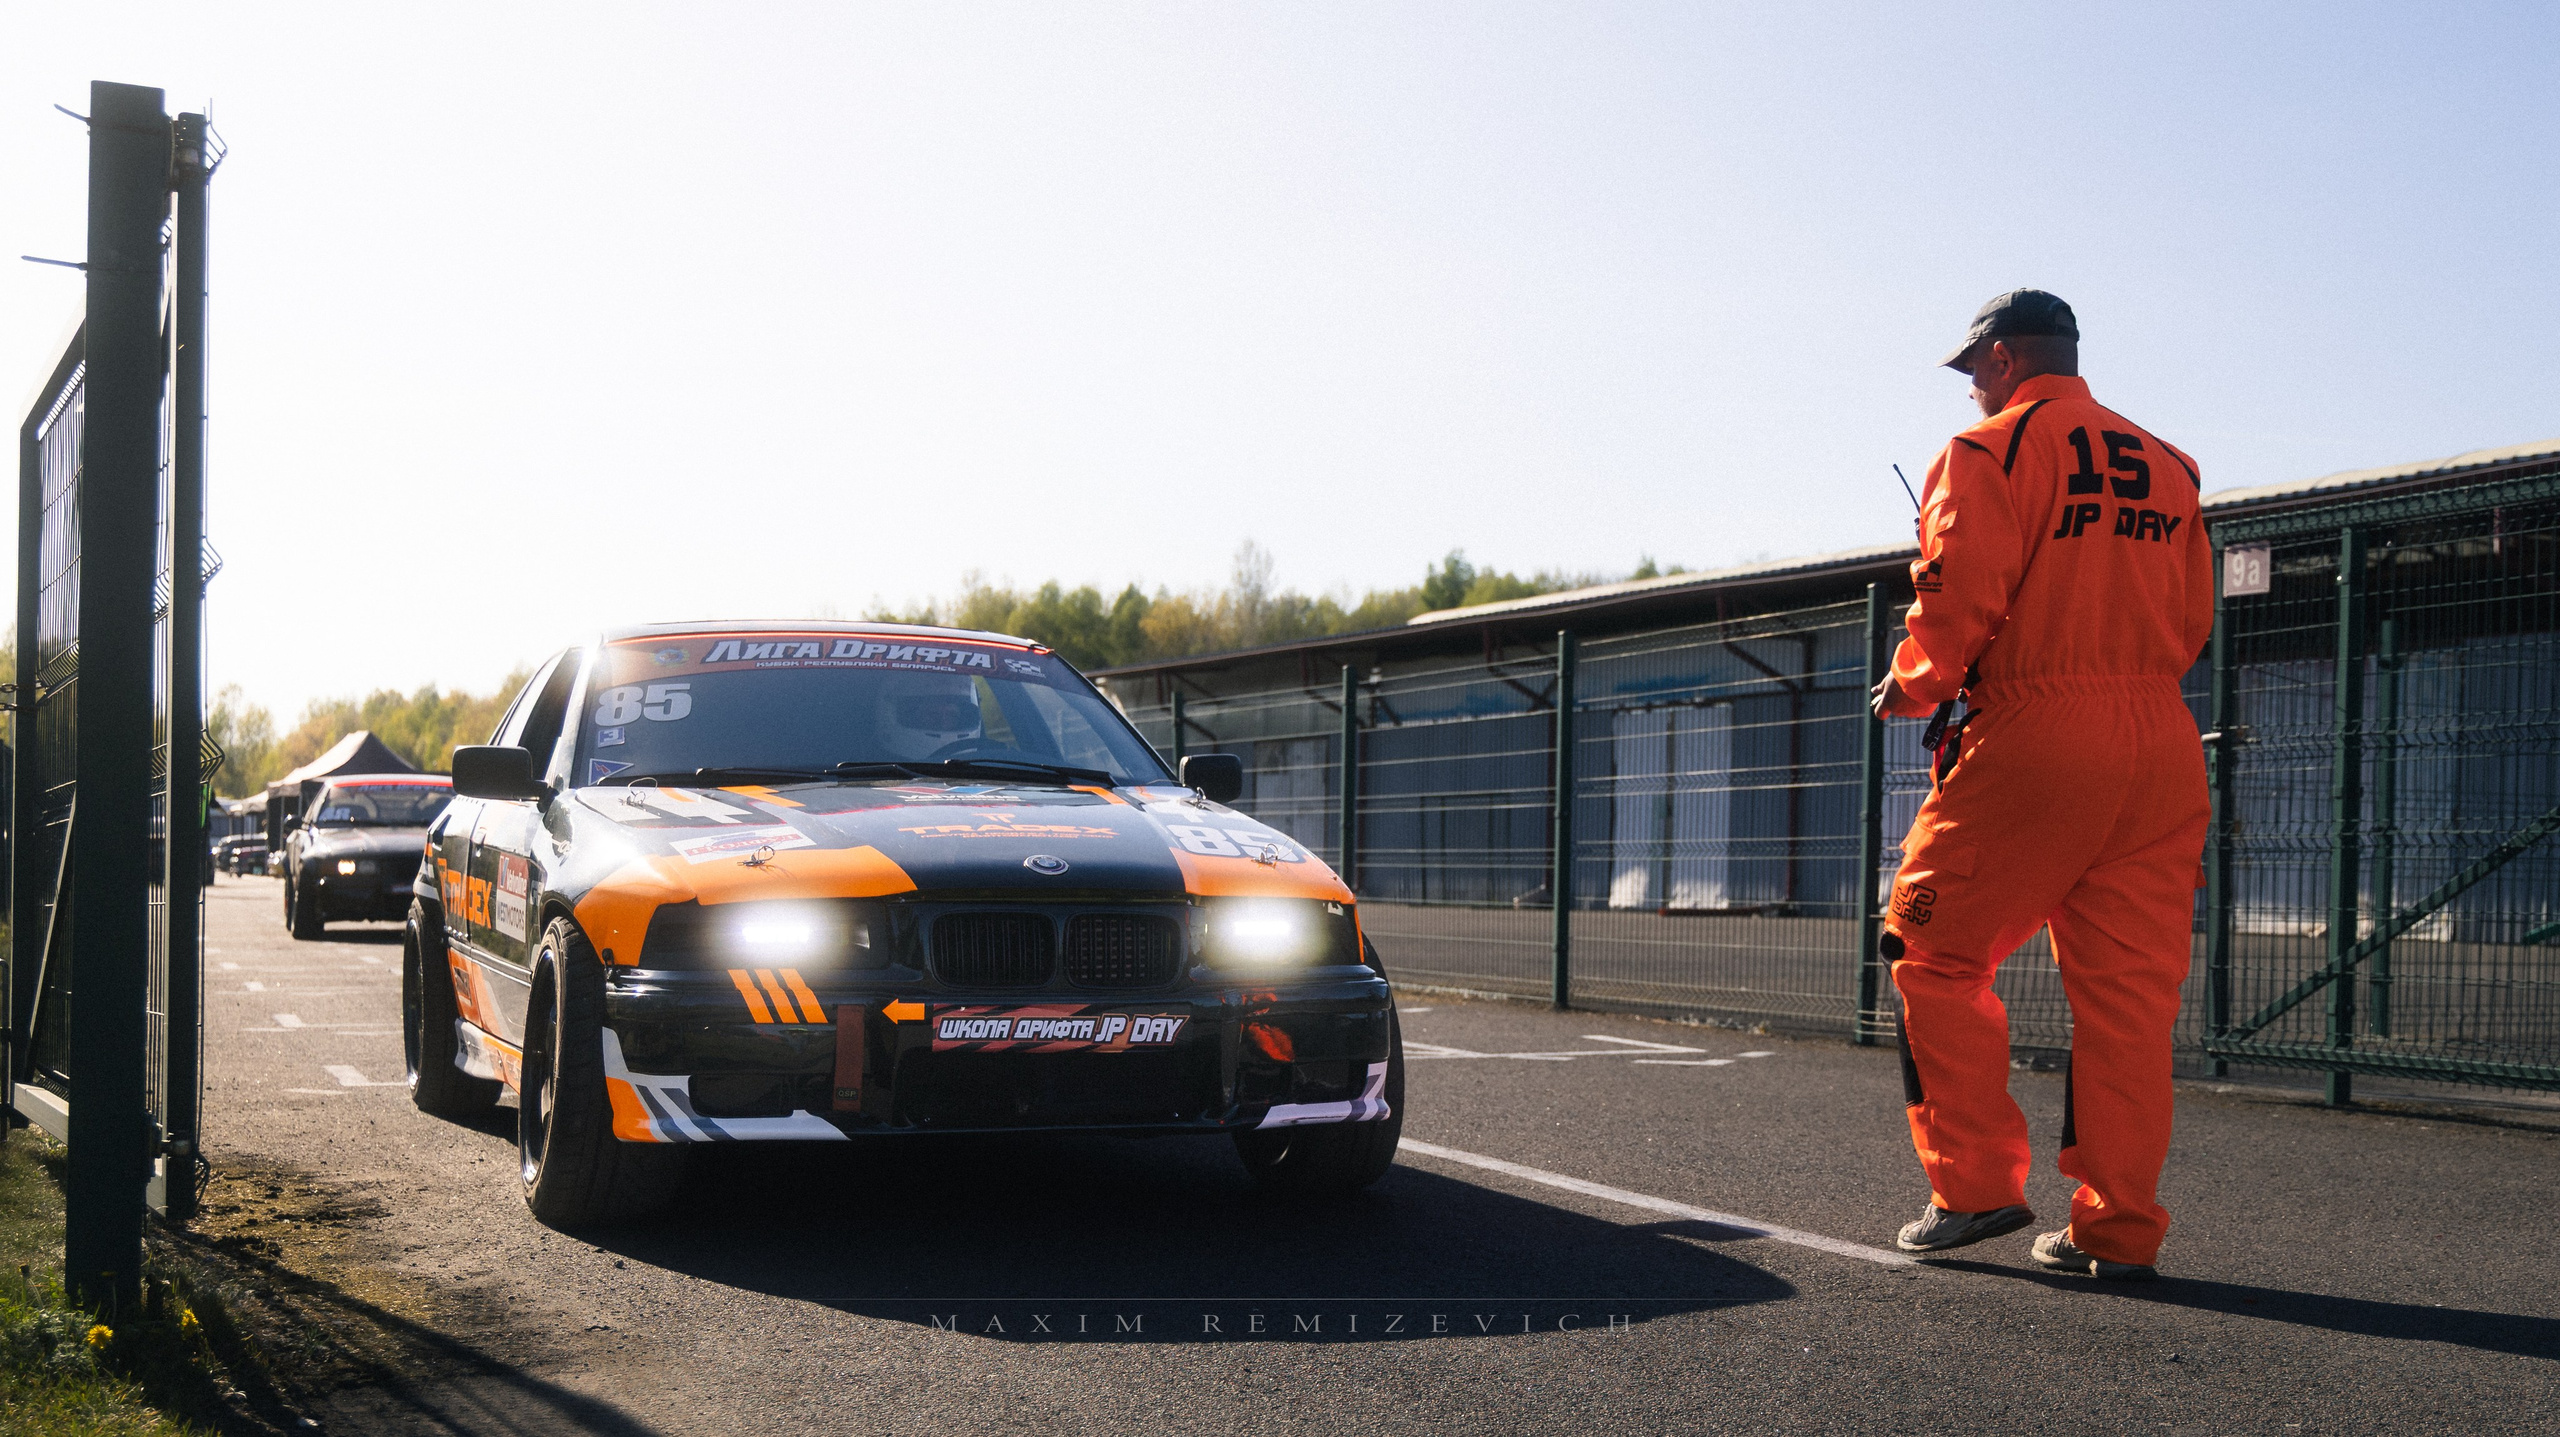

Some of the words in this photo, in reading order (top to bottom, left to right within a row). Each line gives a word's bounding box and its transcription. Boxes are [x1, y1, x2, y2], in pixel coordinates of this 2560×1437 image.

[2067, 426, 2149, 500] 15
[2053, 503, 2101, 540] JP
[2114, 507, 2182, 544] DAY
[2232, 553, 2260, 587] 9a
[892, 663, 956, 672] БЕЛАРУСЬ
[595, 683, 692, 727] 85
[898, 824, 1120, 836] TRADEX
[1166, 824, 1300, 861] 85
[447, 869, 492, 930] TRADEX
[939, 1020, 1009, 1039] ШКОЛА
[1014, 1020, 1095, 1039] ДРИФТА
[1094, 1017, 1127, 1042] JP
[1129, 1017, 1183, 1042] DAY
